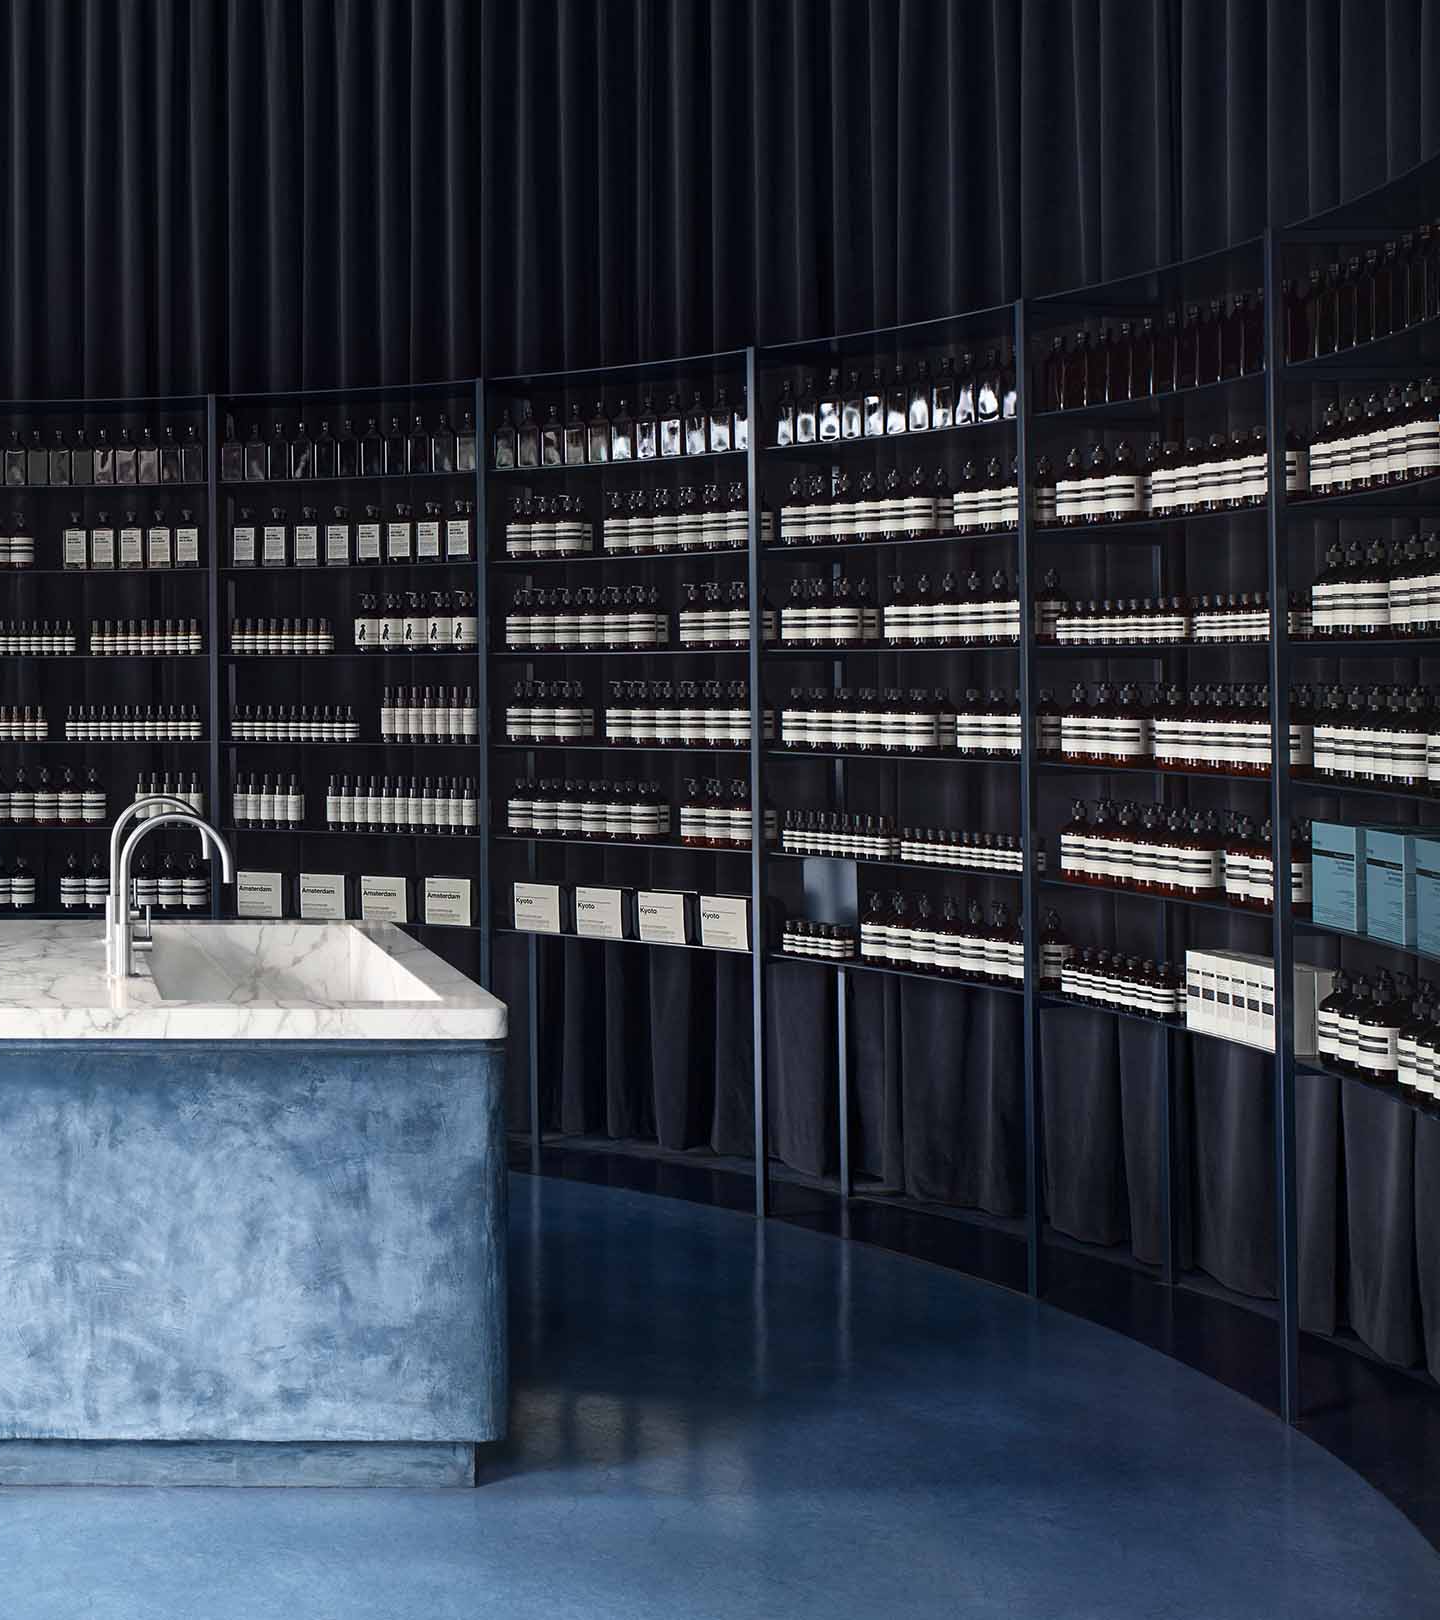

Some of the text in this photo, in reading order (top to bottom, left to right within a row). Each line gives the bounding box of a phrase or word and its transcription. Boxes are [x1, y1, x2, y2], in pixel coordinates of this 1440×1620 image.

[515, 897, 533, 905] Kyoto
[577, 902, 595, 910] Kyoto
[702, 912, 720, 920] Kyoto
